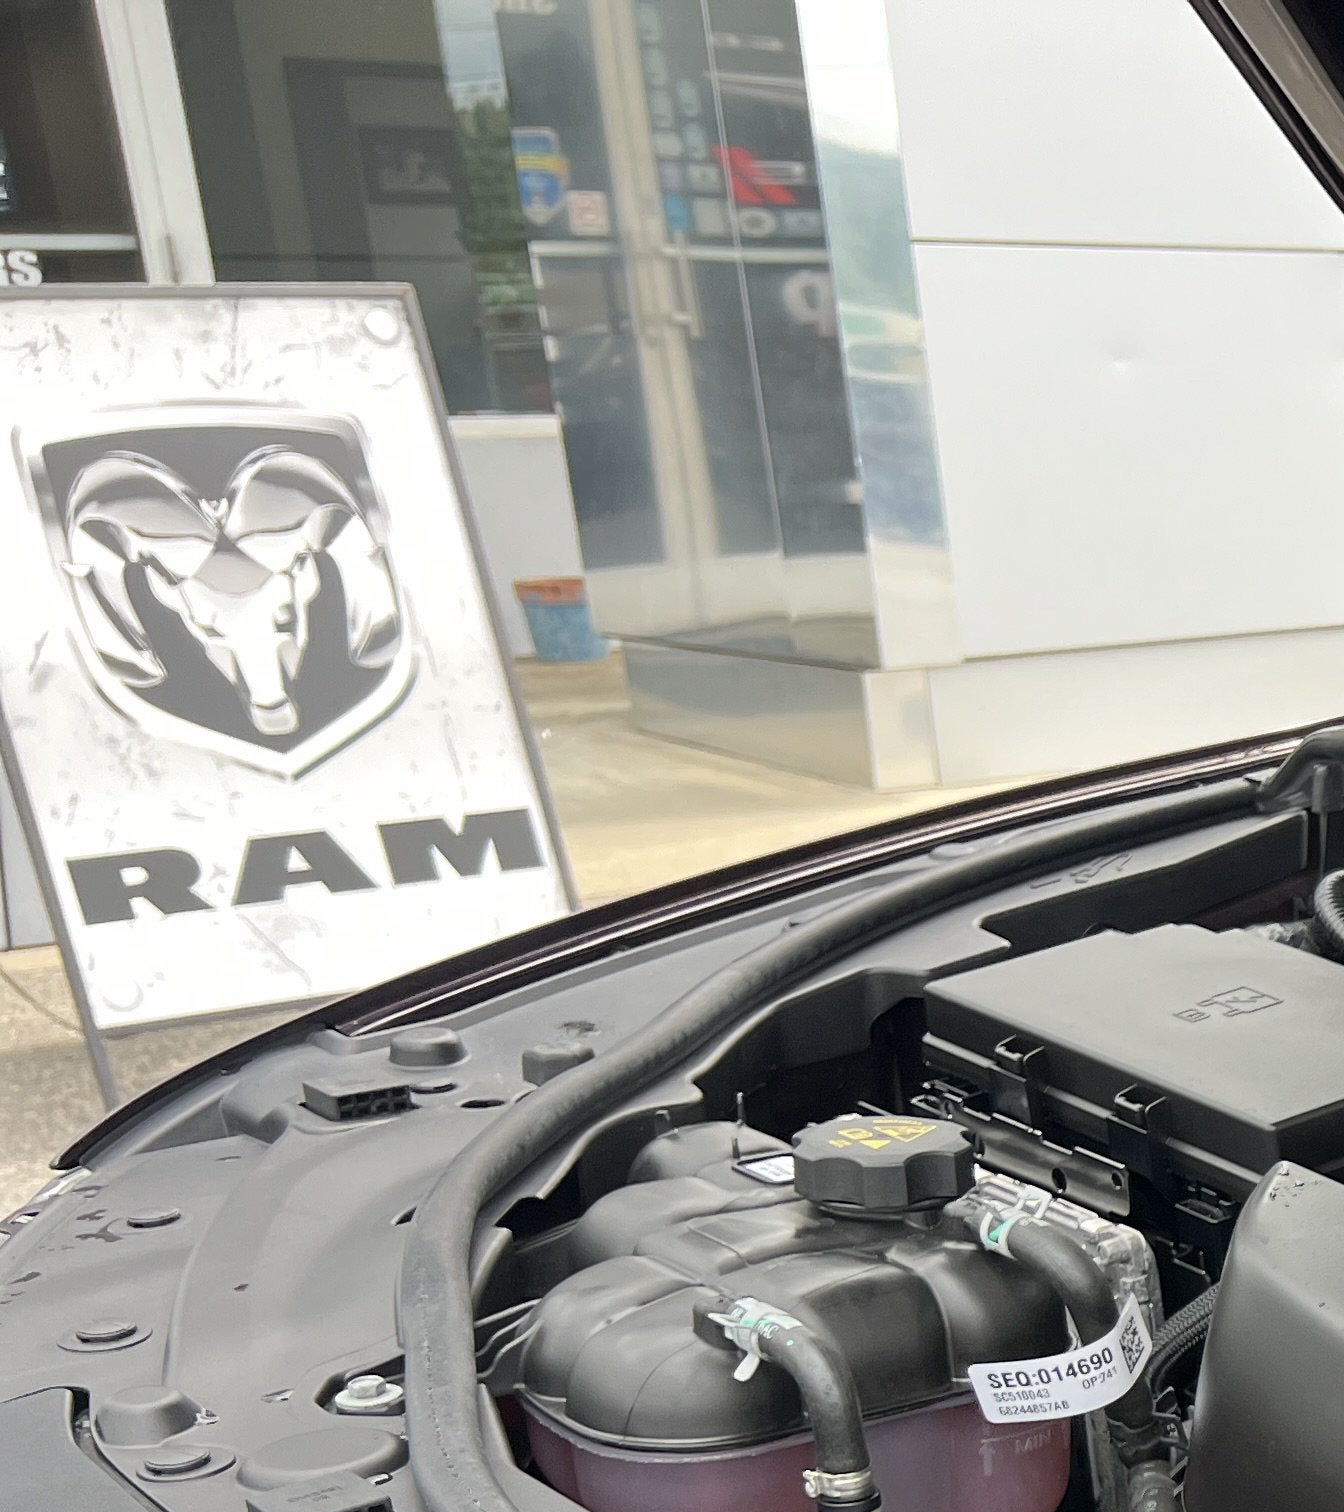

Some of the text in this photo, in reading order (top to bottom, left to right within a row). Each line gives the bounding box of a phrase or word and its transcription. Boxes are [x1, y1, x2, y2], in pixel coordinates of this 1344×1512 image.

[0, 250, 42, 287] S
[65, 808, 545, 925] RAM
[987, 1347, 1113, 1389] SEQ:014690
